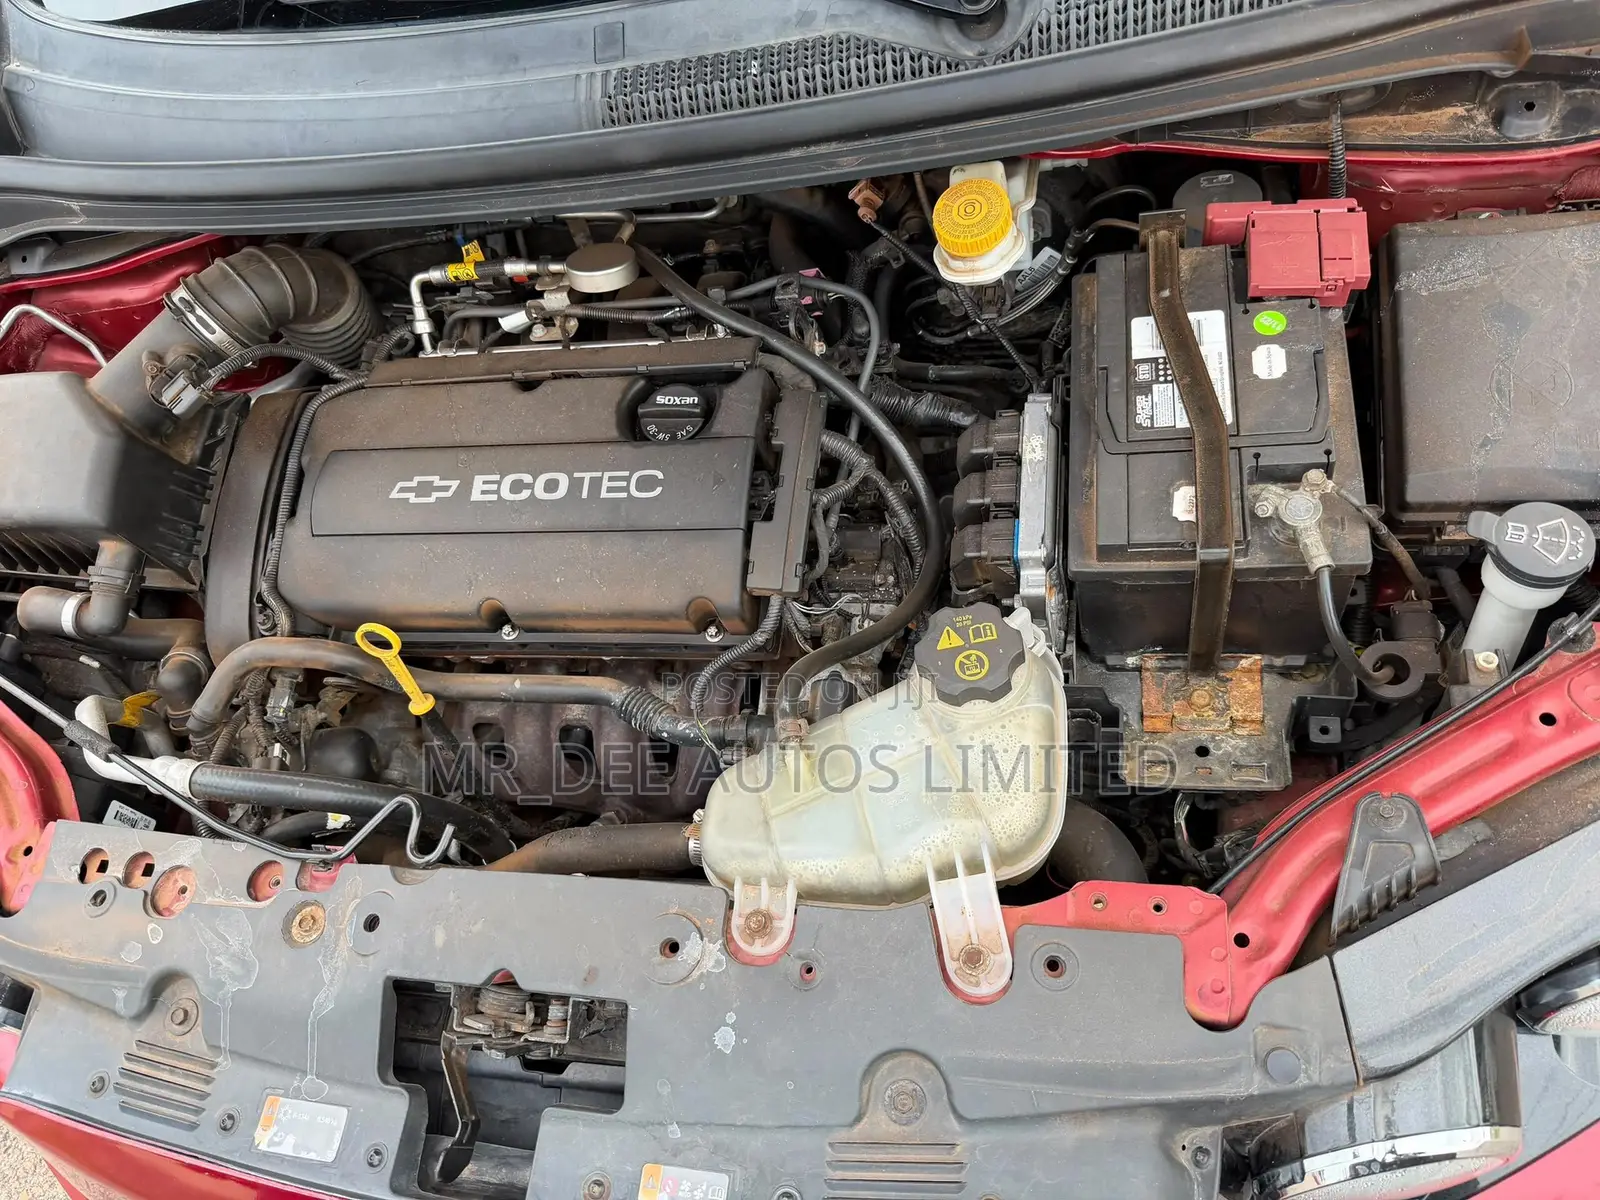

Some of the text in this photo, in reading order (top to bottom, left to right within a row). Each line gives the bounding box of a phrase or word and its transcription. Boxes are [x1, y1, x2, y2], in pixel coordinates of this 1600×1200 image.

[1136, 395, 1145, 424] SUPER
[1142, 393, 1153, 428] START
[646, 424, 694, 441] SAE 5W-30
[470, 469, 665, 502] ECOTEC
